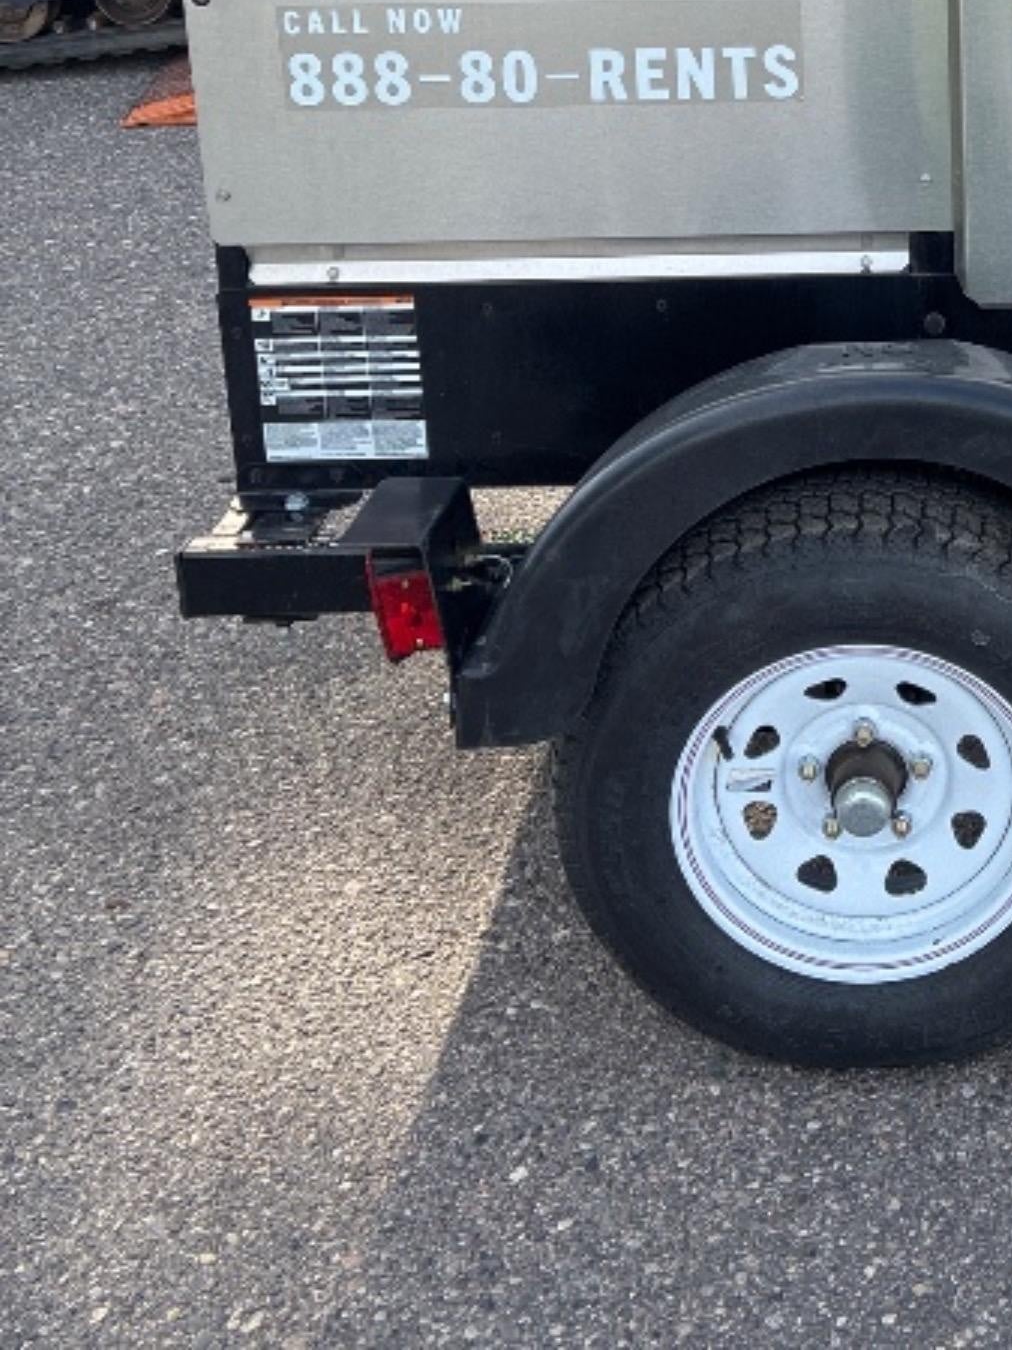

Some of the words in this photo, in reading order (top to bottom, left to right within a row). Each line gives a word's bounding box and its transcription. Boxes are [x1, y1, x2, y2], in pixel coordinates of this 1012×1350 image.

[283, 8, 369, 34] CALL
[387, 8, 463, 33] NOW
[288, 44, 800, 106] 888-80-RENTS
